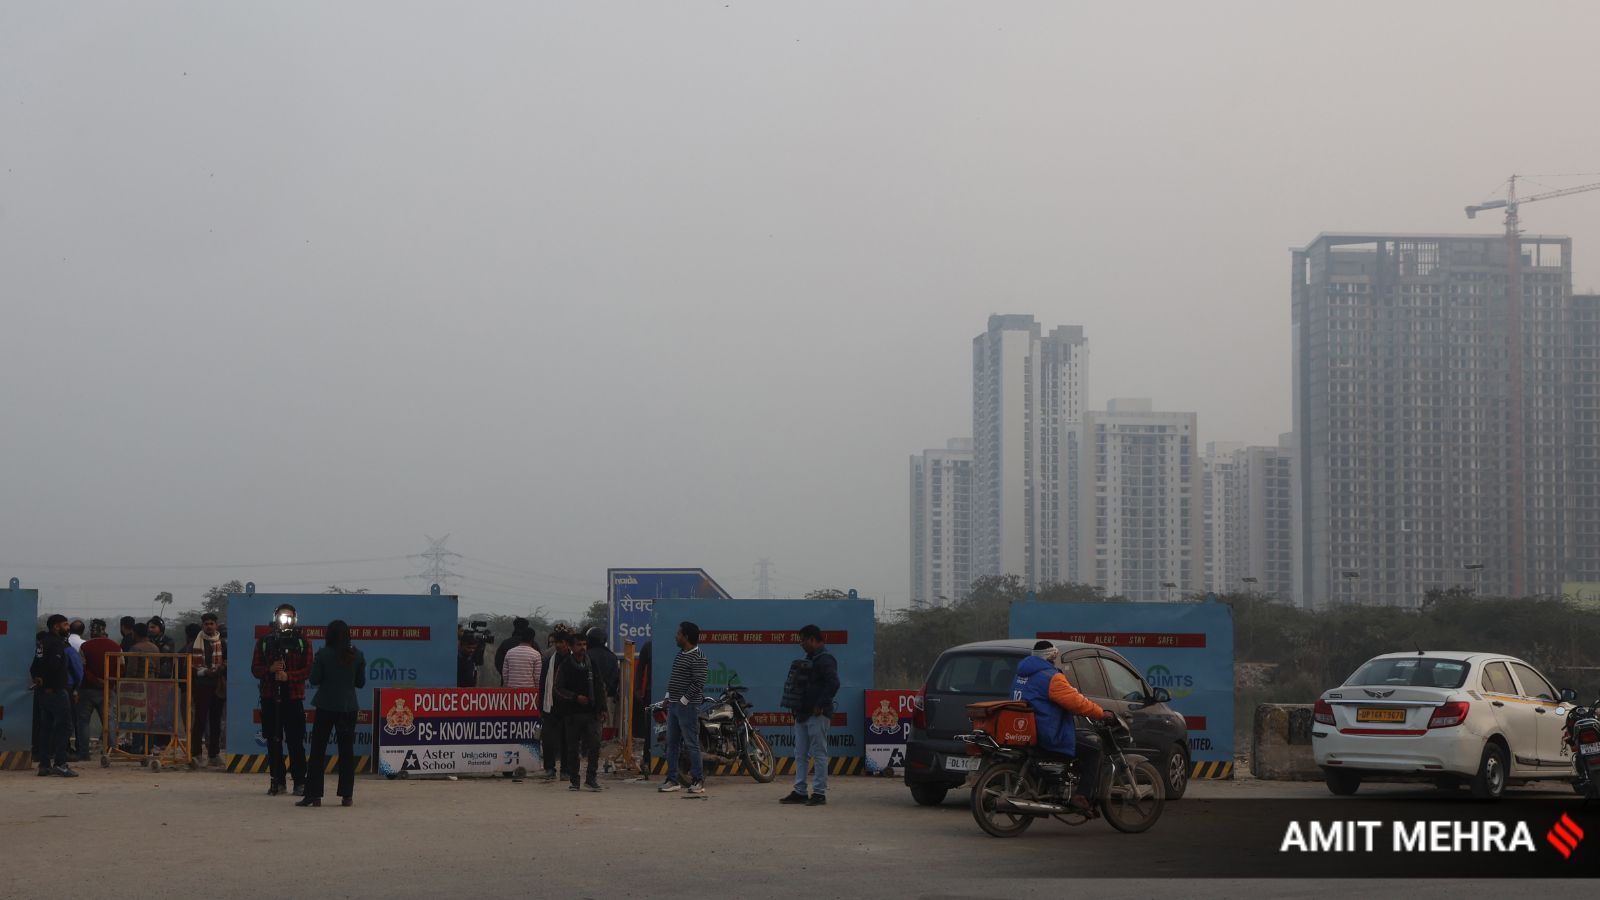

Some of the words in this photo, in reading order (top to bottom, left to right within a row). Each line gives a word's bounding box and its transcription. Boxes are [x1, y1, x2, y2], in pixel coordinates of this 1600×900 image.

[770, 633, 784, 642] THEY
[370, 668, 417, 680] DIMTS
[1147, 675, 1193, 687] DIMTS
[414, 693, 458, 712] POLICE
[461, 693, 511, 712] CHOWKI
[514, 692, 538, 710] NPX
[418, 722, 437, 741] PS-
[440, 722, 508, 740] KNOWLEDGE
[510, 721, 536, 740] PARK
[1005, 732, 1032, 742] Swiggy
[422, 749, 456, 760] Aster
[462, 751, 498, 760] Unlocking
[422, 760, 456, 770] School
